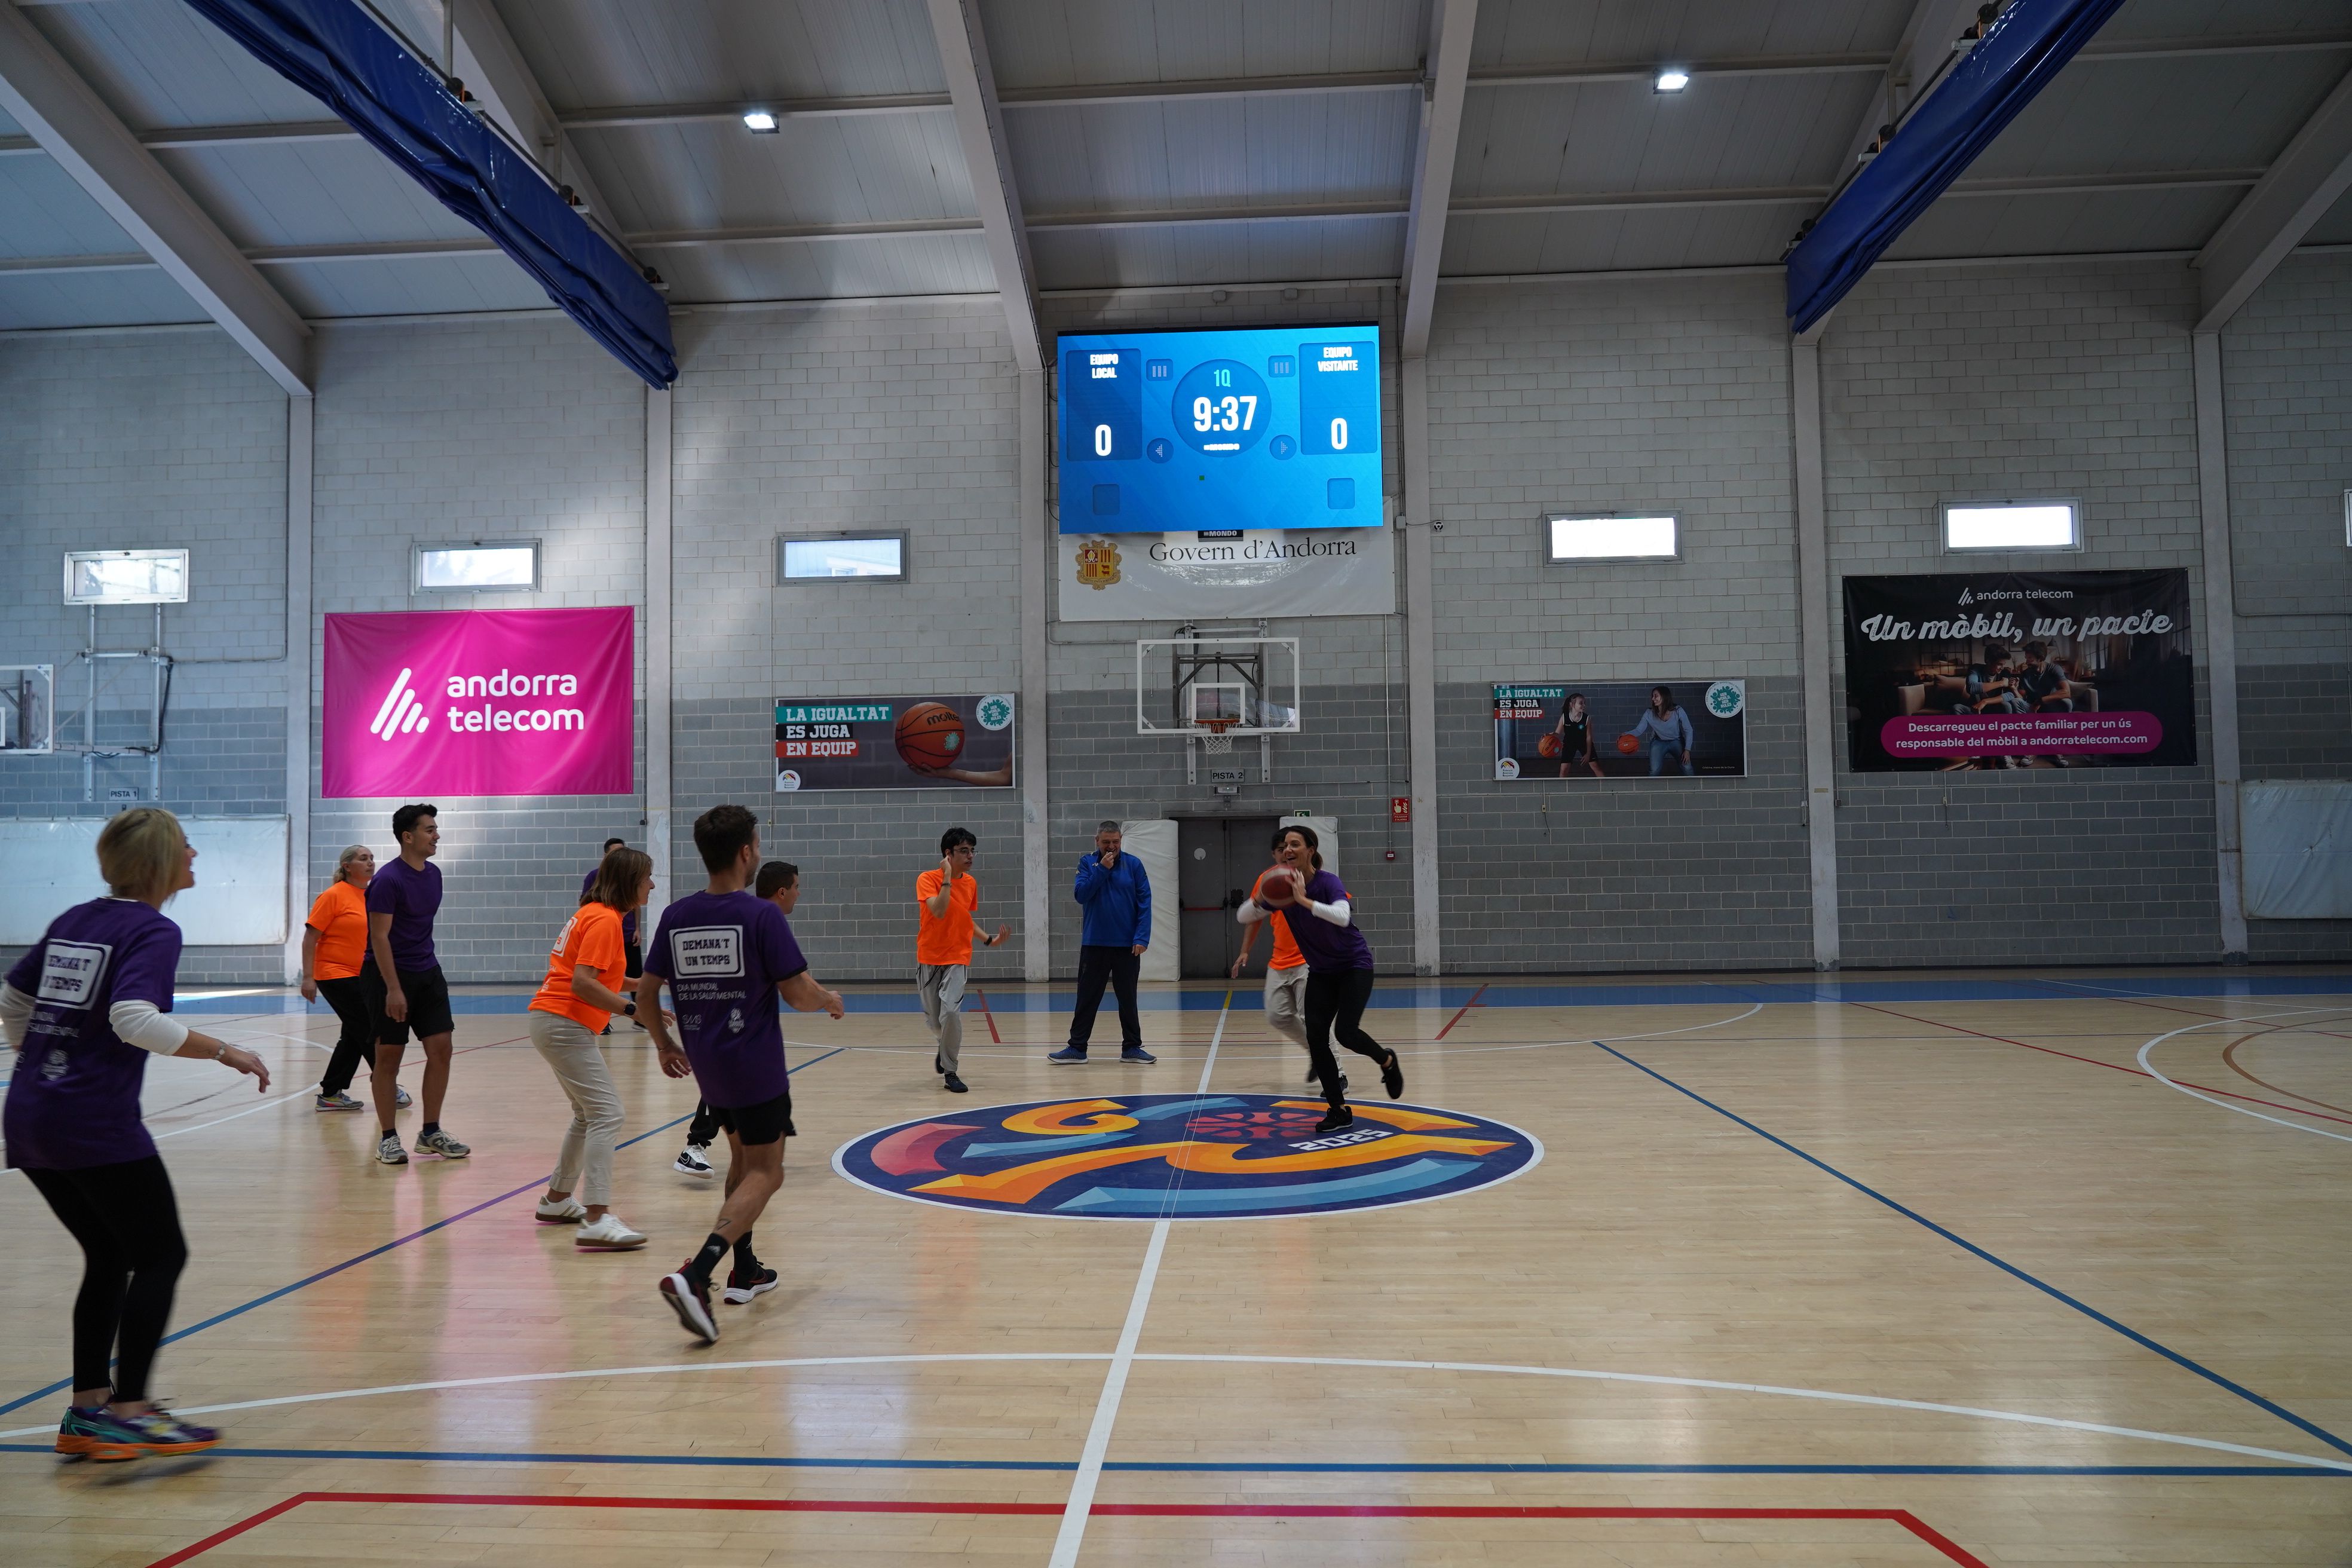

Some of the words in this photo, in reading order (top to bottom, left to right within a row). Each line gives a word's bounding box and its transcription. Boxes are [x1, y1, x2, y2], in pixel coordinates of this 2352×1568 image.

[1090, 354, 1119, 365] EQUIPO
[1323, 346, 1352, 358] EQUIPO
[1091, 367, 1117, 379] LOCAL
[1317, 360, 1358, 372] VISITANTE
[1214, 369, 1231, 387] 1Q
[1193, 396, 1257, 432] 9:37
[1095, 424, 1111, 456] 0
[1330, 418, 1348, 450] 0
[1149, 542, 1235, 561] Govern
[1244, 537, 1357, 559] d'Andorra
[1977, 589, 2023, 601] andorra
[2025, 589, 2074, 600] telecom
[1860, 614, 1915, 642] Un
[1918, 612, 2023, 644] mòbil,
[2031, 616, 2077, 637] un
[2077, 609, 2173, 642] pacte
[446, 668, 577, 698] andorra
[1499, 690, 1512, 698] LA
[1514, 689, 1562, 697] IGUALTAT
[447, 703, 584, 733] telecom
[786, 708, 807, 721] LA
[811, 706, 889, 721] IGUALTAT
[1500, 710, 1512, 718] EN
[1515, 709, 1543, 718] EQUIP
[786, 725, 806, 739] ES
[809, 724, 850, 738] JUGA
[1909, 722, 1986, 733] Descarregueu
[1988, 721, 1998, 730] el
[2001, 721, 2032, 733] pacte
[2035, 719, 2078, 730] familiar
[2080, 721, 2099, 731] per
[2102, 720, 2116, 728] un
[2118, 718, 2132, 728] ús
[786, 743, 807, 756] EN
[811, 741, 856, 757] EQUIP
[1896, 737, 1965, 750] responsable
[1967, 736, 1984, 747] del
[1987, 736, 2019, 746] mòbil
[2029, 734, 2148, 746] andorratelecom.com
[682, 938, 730, 951] DEMANA'T
[685, 956, 698, 966] UN
[700, 955, 730, 966] TEMPS
[1287, 1128, 1394, 1152] 2025
